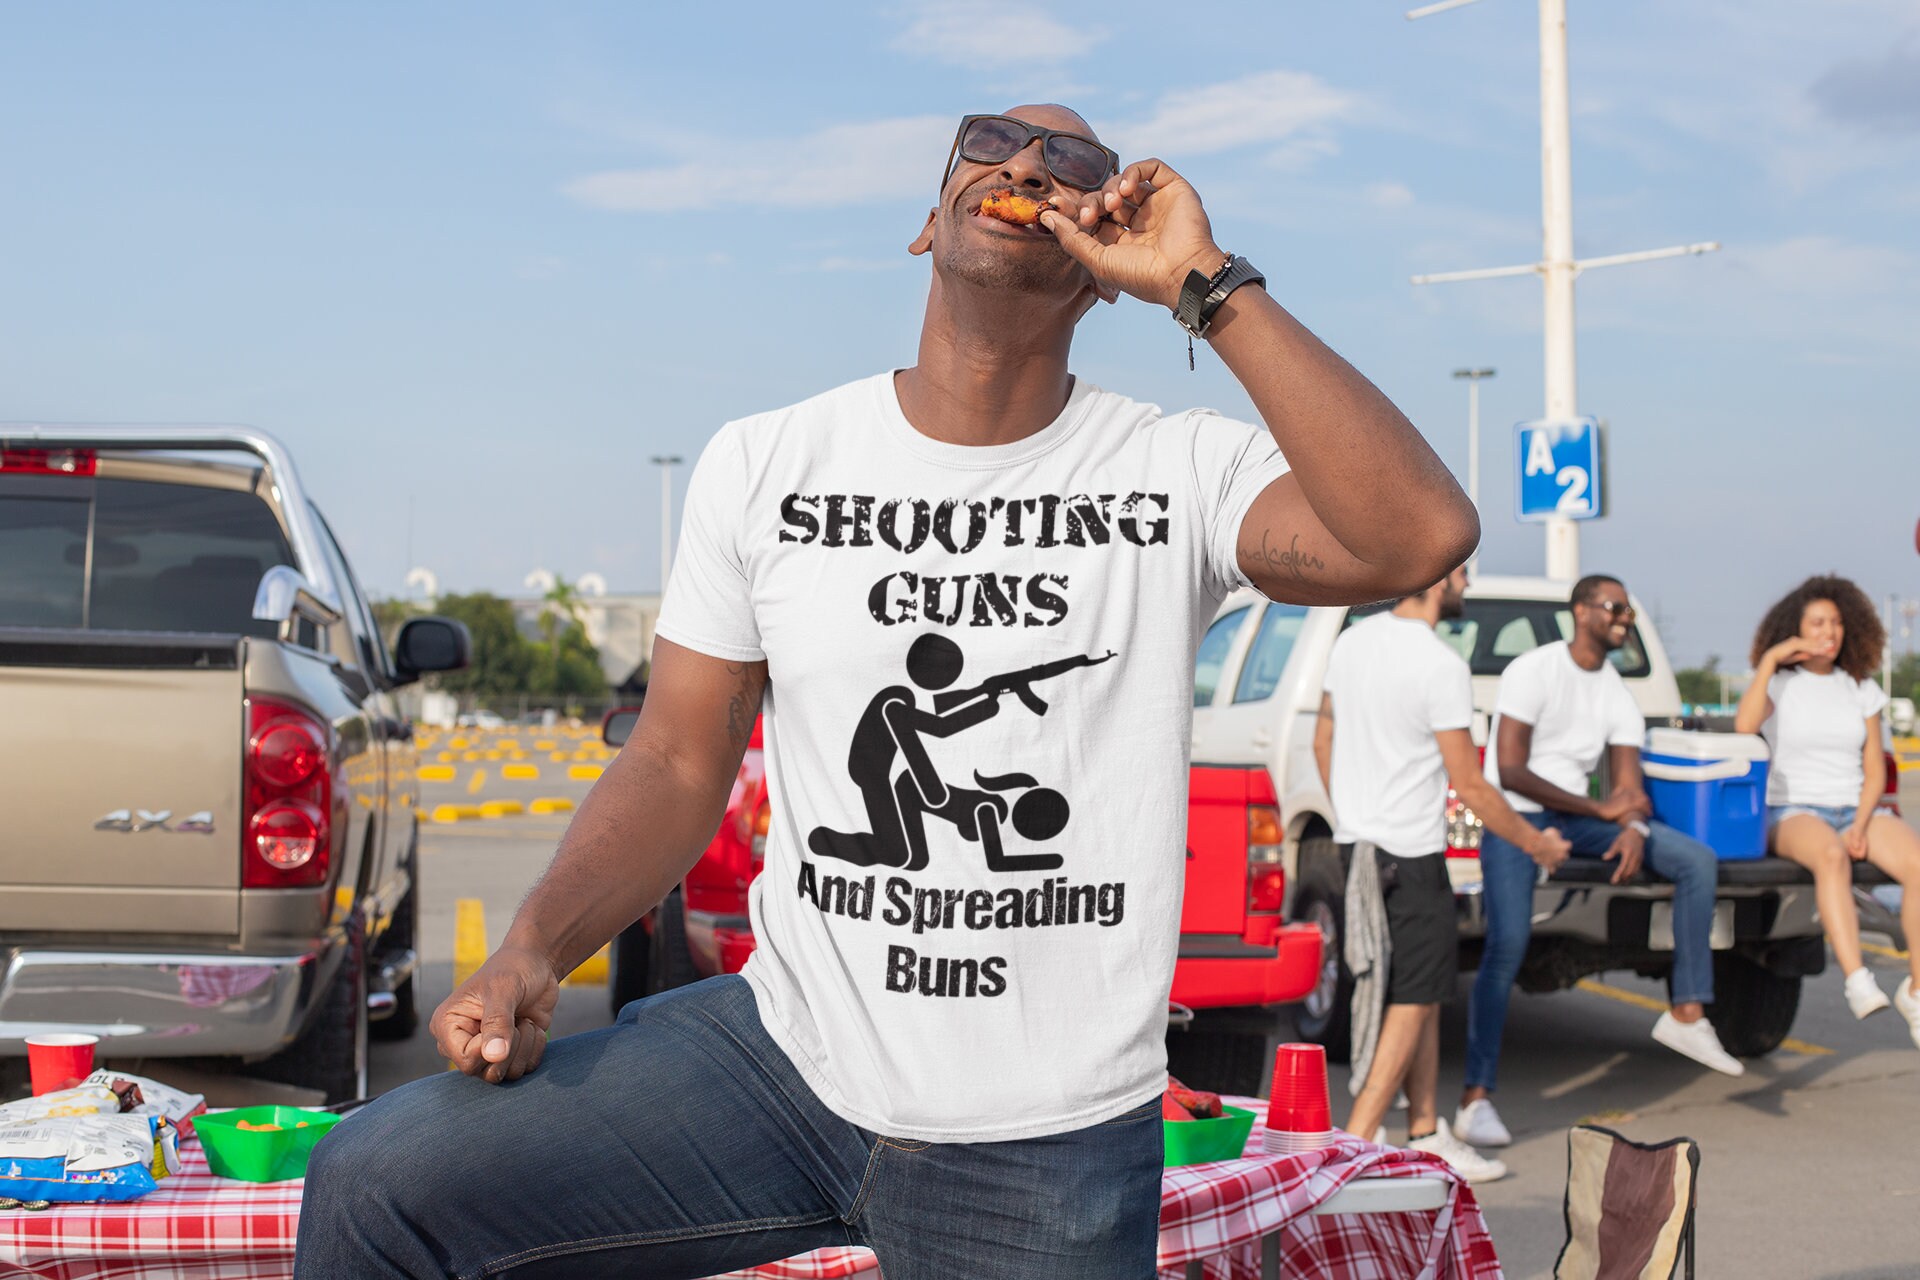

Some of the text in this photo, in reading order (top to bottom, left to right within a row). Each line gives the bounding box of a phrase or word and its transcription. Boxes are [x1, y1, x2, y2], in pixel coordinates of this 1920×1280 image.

[1525, 430, 1556, 477] A
[1555, 465, 1590, 513] 2
[778, 491, 1169, 555] SHOOTING
[867, 571, 1069, 628] GUNS
[797, 860, 1126, 935] And Spreading
[886, 944, 1008, 998] Buns
